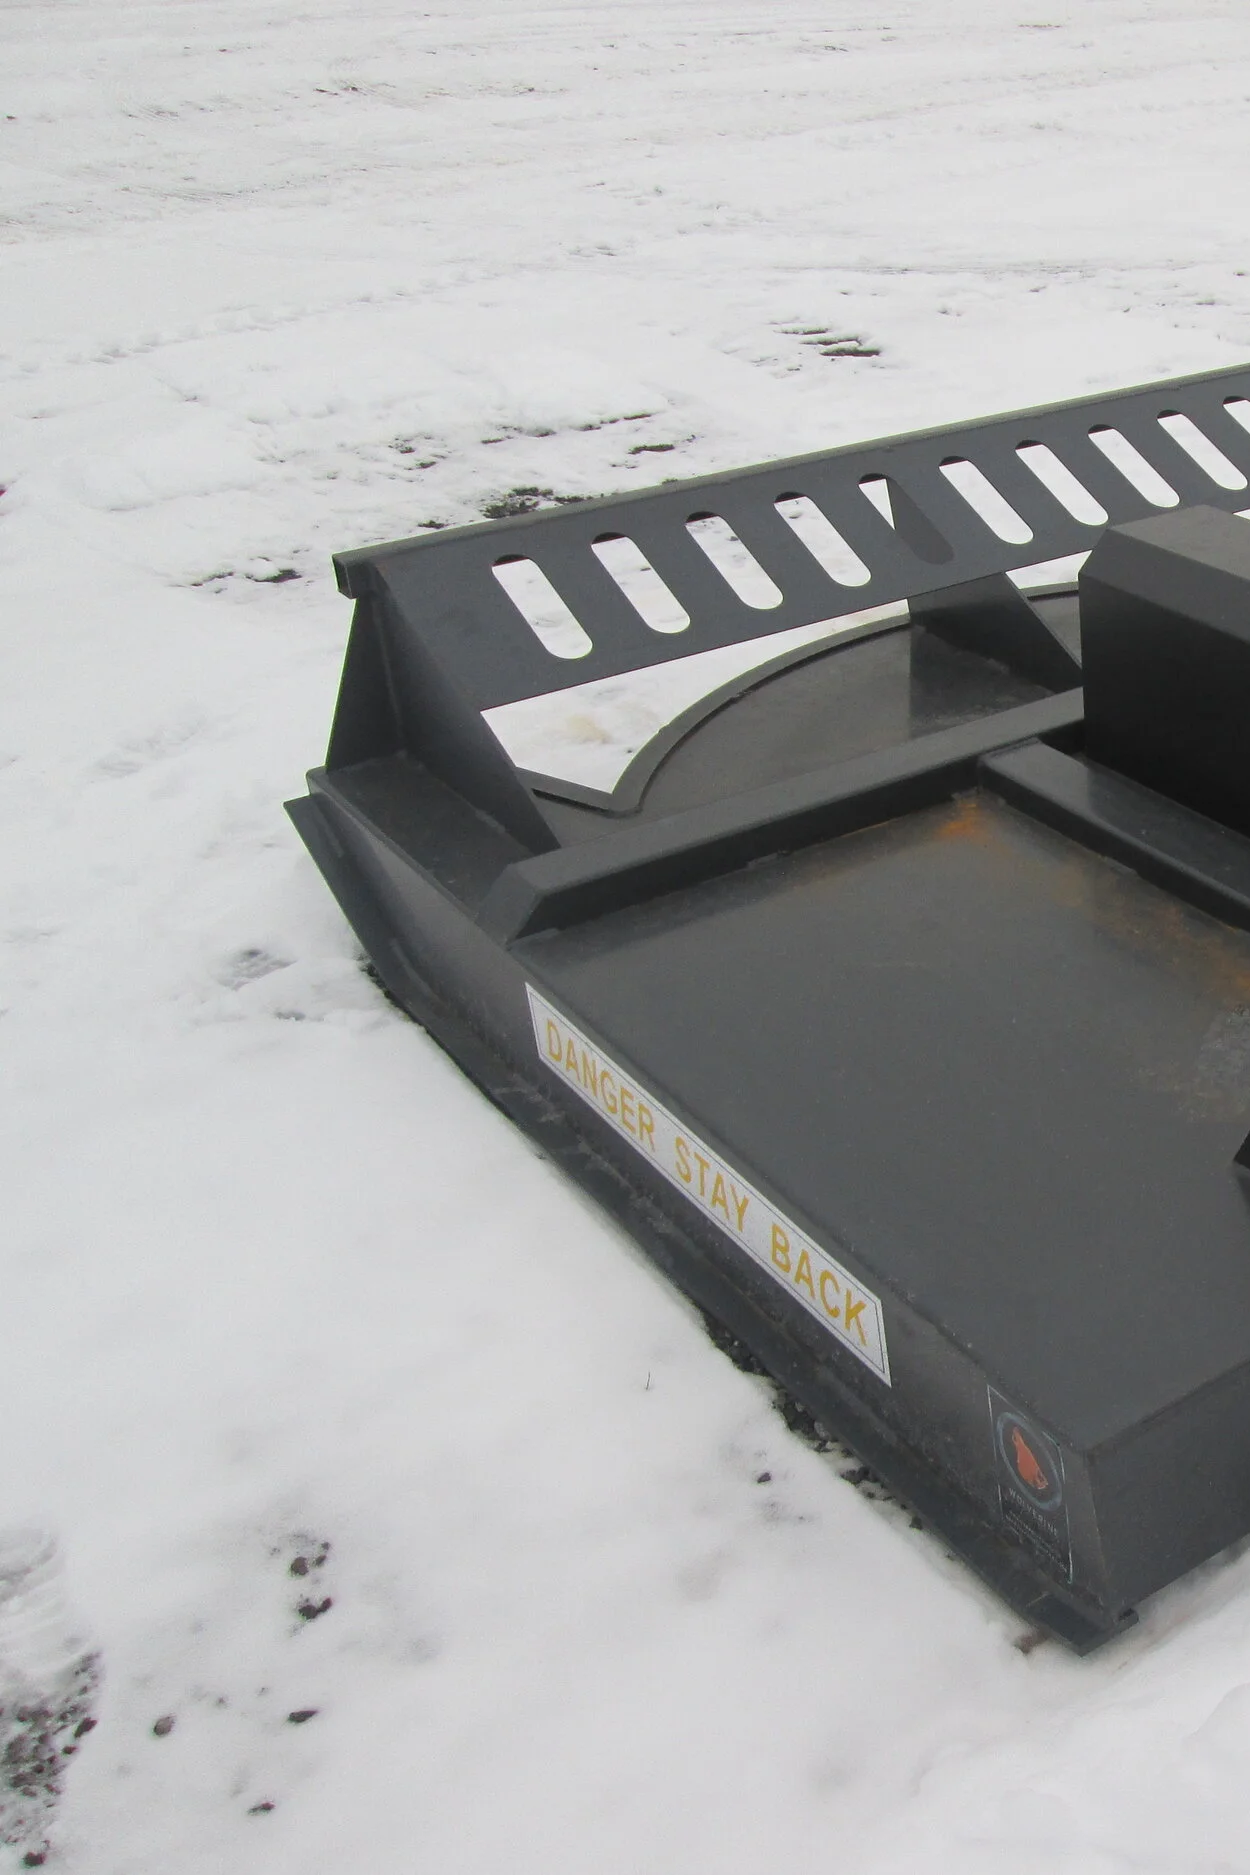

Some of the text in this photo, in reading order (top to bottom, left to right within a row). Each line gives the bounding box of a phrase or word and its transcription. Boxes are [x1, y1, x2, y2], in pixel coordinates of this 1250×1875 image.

[546, 1019, 868, 1346] DANGER STAY BACK
